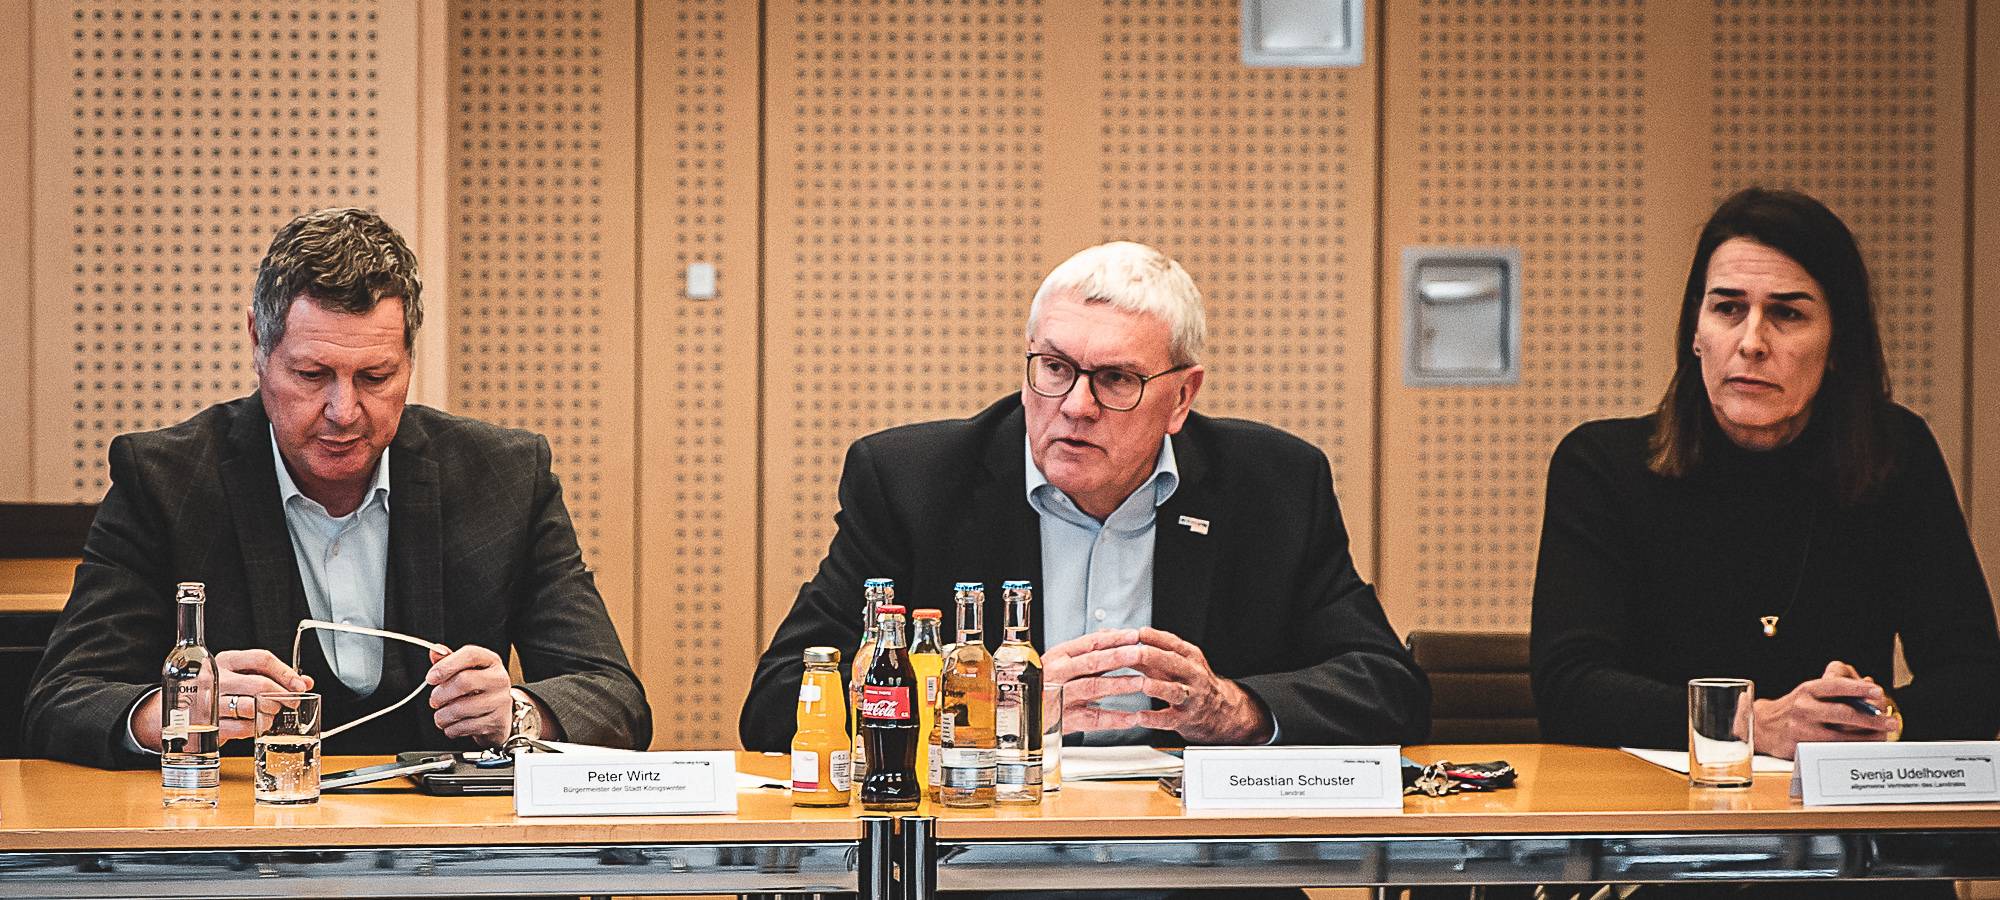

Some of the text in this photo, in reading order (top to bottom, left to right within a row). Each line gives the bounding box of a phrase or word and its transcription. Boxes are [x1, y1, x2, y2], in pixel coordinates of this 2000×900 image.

[588, 770, 661, 782] Peter Wirtz
[1229, 775, 1355, 786] Sebastian Schuster
[1850, 768, 1965, 782] Svenja Udelhoven
[563, 786, 609, 794] Bürgermeister
